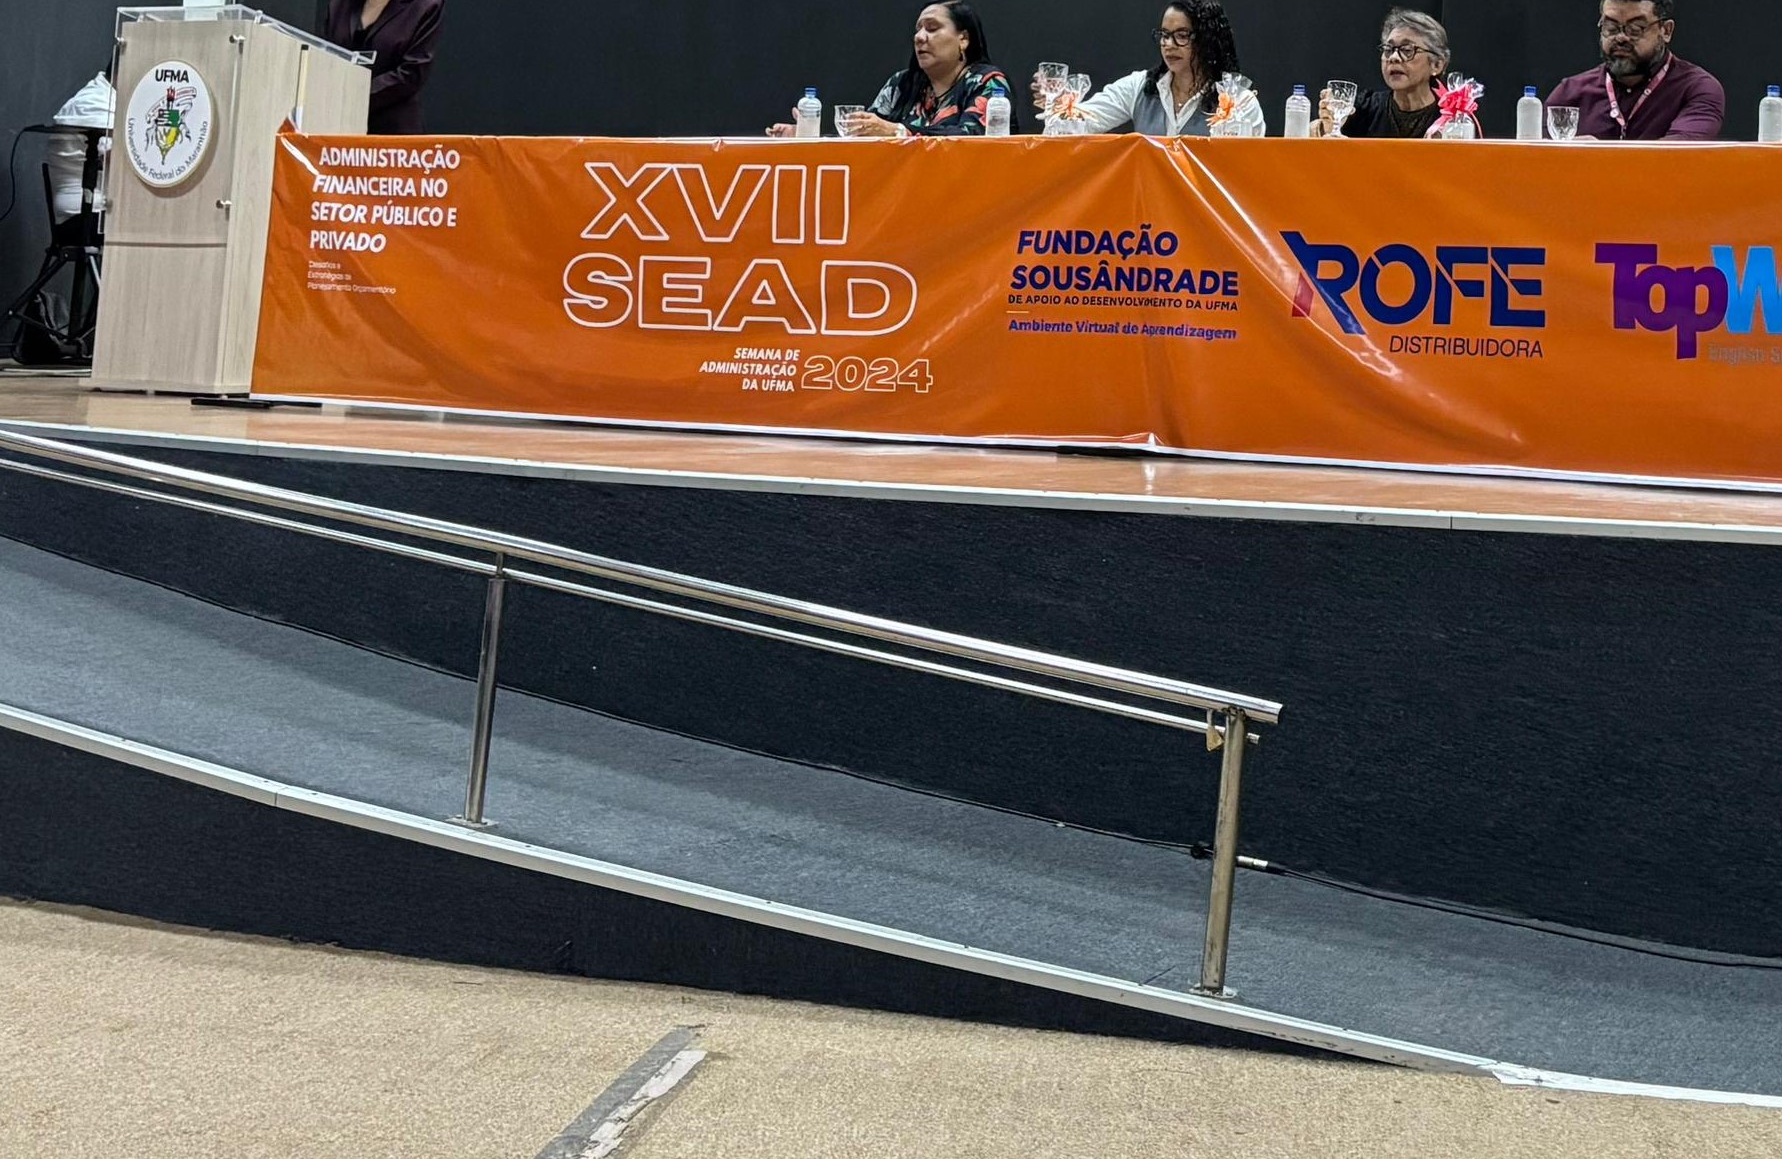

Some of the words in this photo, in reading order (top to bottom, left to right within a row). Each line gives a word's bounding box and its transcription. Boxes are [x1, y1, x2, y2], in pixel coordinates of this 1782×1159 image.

[155, 68, 190, 83] UFMA
[128, 117, 148, 174] Universidade
[148, 167, 175, 180] Federal
[176, 165, 186, 176] do
[185, 120, 209, 169] Maranhão
[319, 144, 460, 174] ADMINISTRAÇÃO
[312, 174, 417, 197] FINANCEIRA
[421, 178, 448, 198] NO
[311, 201, 367, 223] SETOR
[371, 200, 443, 227] PÚBLICO
[447, 208, 458, 227] E
[580, 161, 850, 246] XVII
[310, 230, 387, 253] PRIVADO
[1017, 223, 1179, 260] FUNDAÇÃO
[1010, 260, 1239, 296] SOUSÂNDRADE
[1280, 230, 1546, 335] ROFE
[562, 252, 919, 336] SEAD
[1008, 295, 1023, 304] DE
[1025, 295, 1061, 305] APOIO
[1064, 296, 1079, 305] AO
[1082, 296, 1182, 308] DESENVOLVIMENTO
[1186, 299, 1202, 310] DA
[1205, 300, 1238, 311] UFMA
[1008, 319, 1073, 333] Ambiente
[1076, 320, 1120, 334] Virtual
[1122, 322, 1138, 334] de
[1141, 323, 1237, 341] Aprendizagem
[733, 347, 782, 361] SEMANA
[785, 349, 801, 361] DE
[1389, 335, 1544, 358] DISTRIBUIDORA
[699, 361, 797, 380] ADMINISTRAÇÃO
[801, 355, 934, 393] 2024
[742, 378, 758, 391] DA
[762, 379, 795, 392] UFMA
